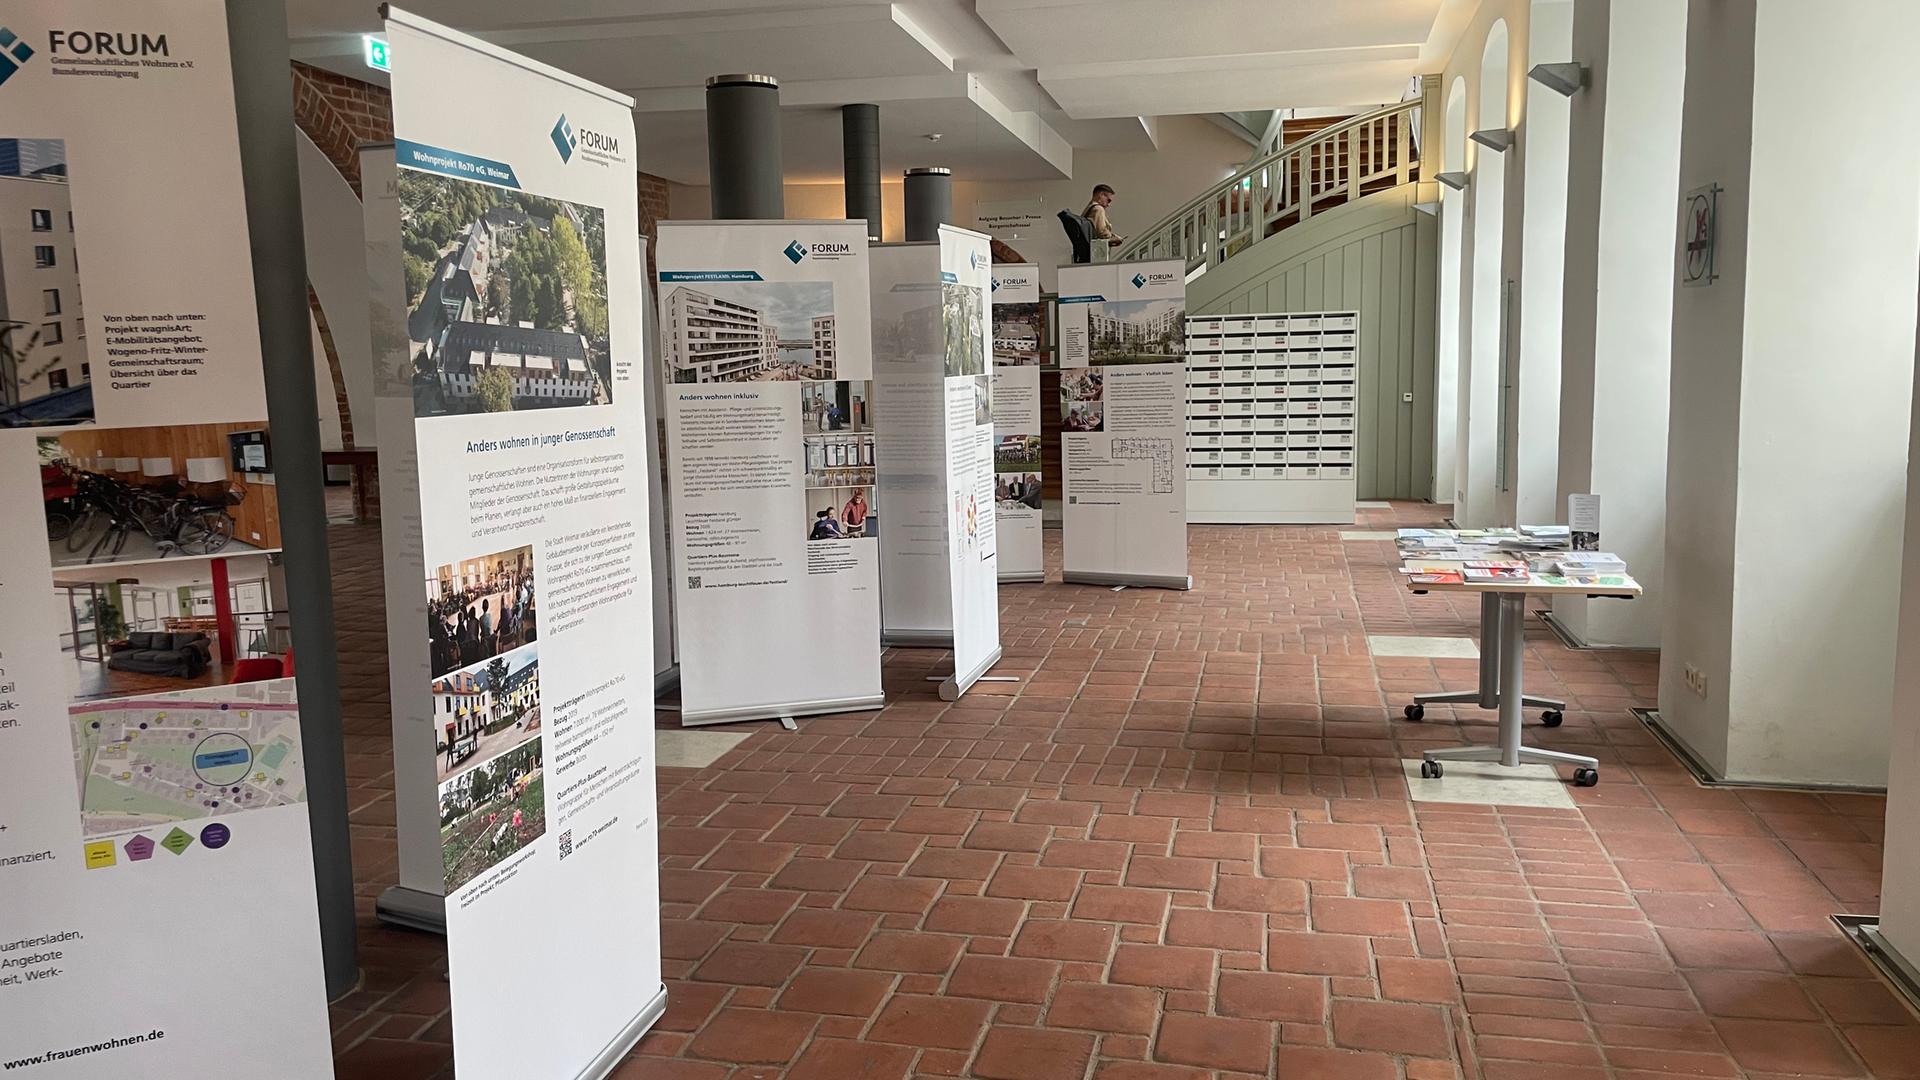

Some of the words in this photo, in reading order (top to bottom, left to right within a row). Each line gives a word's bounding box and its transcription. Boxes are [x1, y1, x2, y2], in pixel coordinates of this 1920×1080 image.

[49, 30, 169, 56] FORUM
[51, 56, 139, 67] Gemeinschaftliches
[142, 59, 178, 68] Wohnen
[180, 60, 194, 68] e.V.
[52, 67, 139, 79] Bundesvereinigung
[581, 129, 618, 154] FORUM
[413, 150, 457, 168] Wohnprojekt
[458, 160, 474, 172] Ro70
[488, 167, 509, 179] Weimar
[812, 244, 849, 252] FORUM
[105, 326, 138, 335] Projekt
[110, 369, 155, 378] Übersicht
[181, 368, 197, 376] das
[111, 381, 151, 390] Quartier
[467, 441, 497, 453] Anders
[500, 437, 530, 449] wohnen
[532, 434, 538, 445] in
[540, 433, 564, 447] junger
[565, 425, 615, 441] Genossenschaft
[554, 716, 567, 726] Bezug
[554, 726, 572, 737] Wohnen
[556, 761, 575, 774] Gewerbe
[1, 951, 63, 968] Angebote
[25, 967, 63, 981] Werk-
[4, 1030, 165, 1070] www.frauenwohnen.de
